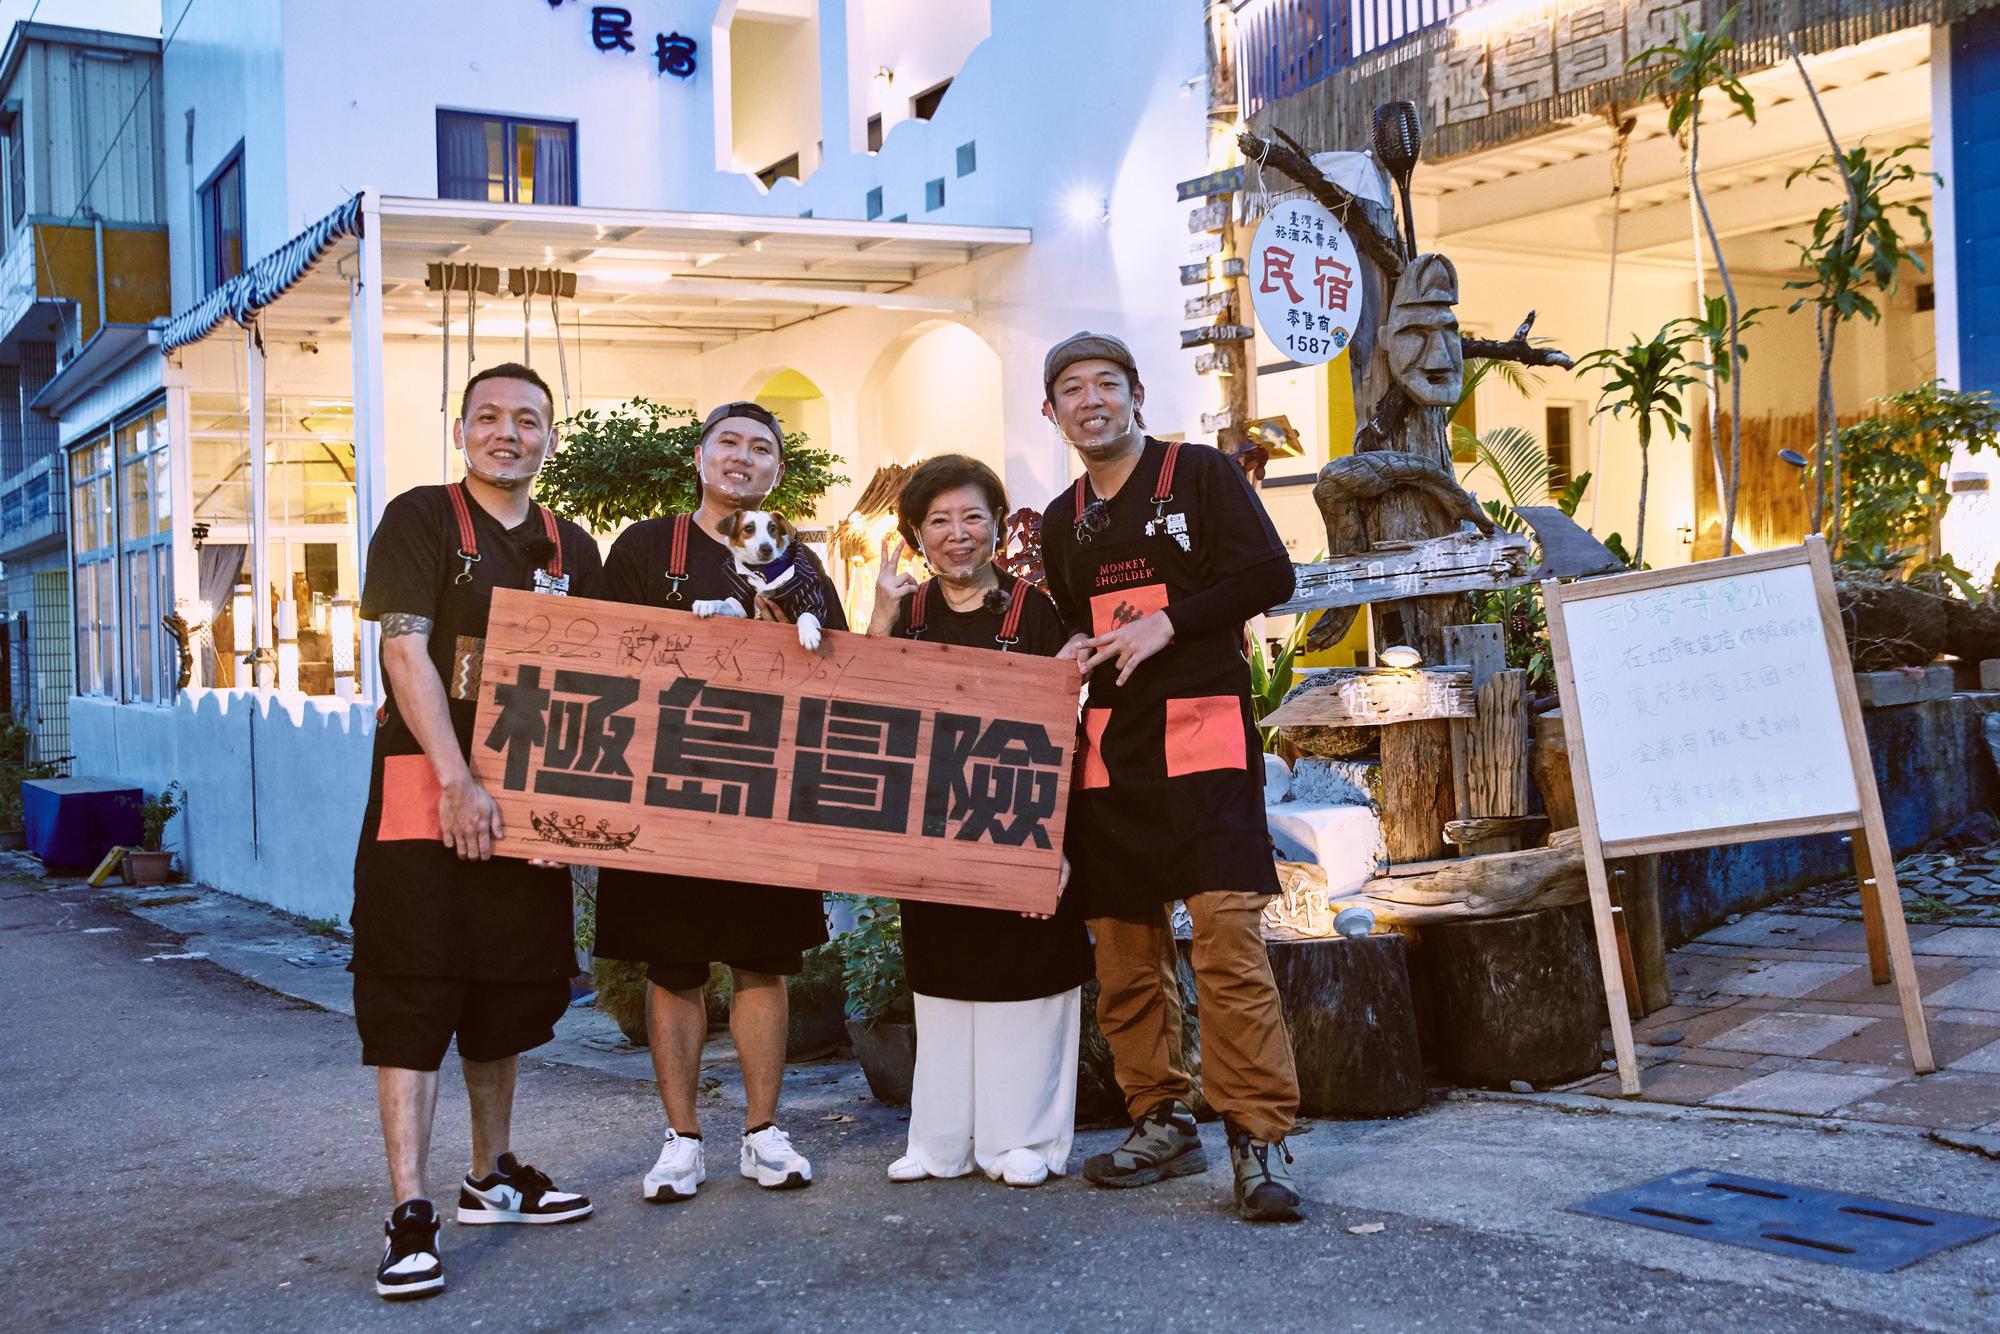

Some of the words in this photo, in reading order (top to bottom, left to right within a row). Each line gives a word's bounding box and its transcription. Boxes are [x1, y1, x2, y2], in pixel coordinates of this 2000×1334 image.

[592, 6, 697, 77] 民宿
[1289, 210, 1325, 231] 臺灣省
[1259, 245, 1354, 312] 民宿
[1287, 308, 1331, 333] 零售商
[1286, 334, 1331, 355] 1587
[1099, 557, 1148, 576] MONKEY
[1095, 570, 1154, 588] SHOULDER
[484, 664, 1064, 851] 極島冒險
